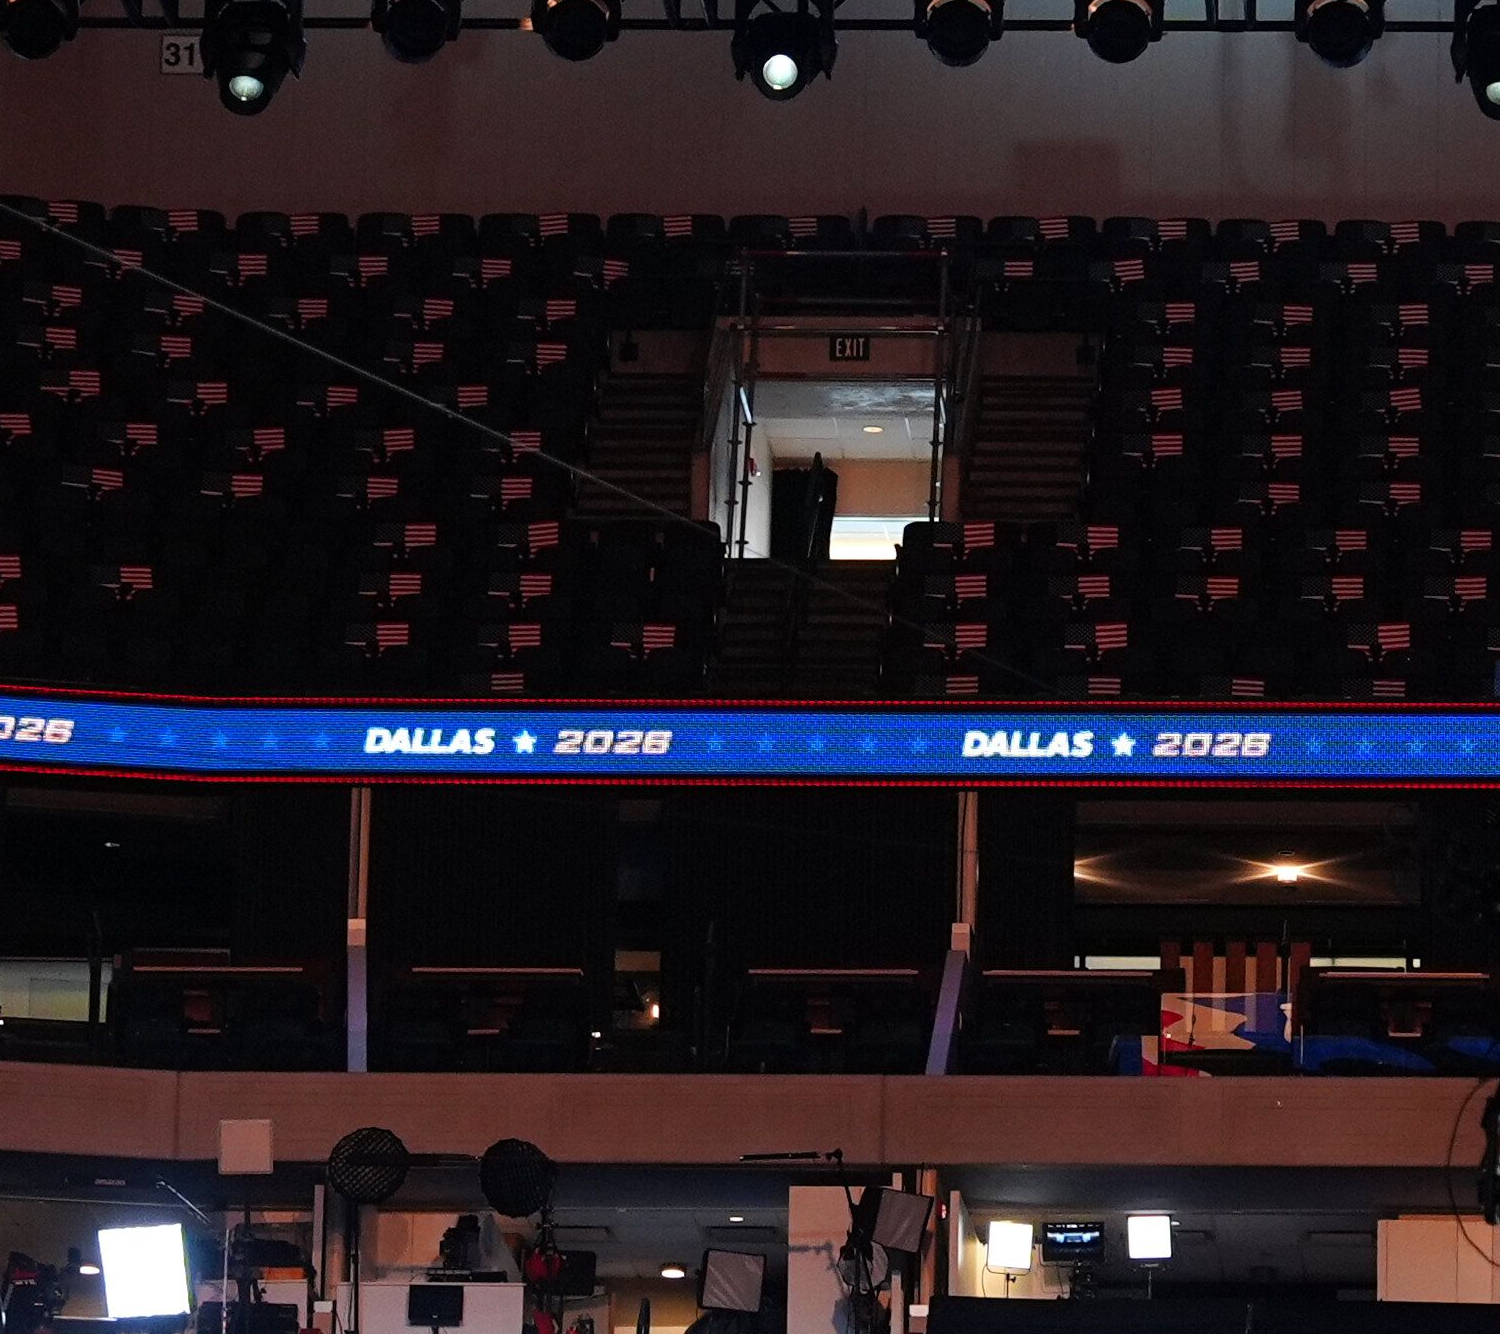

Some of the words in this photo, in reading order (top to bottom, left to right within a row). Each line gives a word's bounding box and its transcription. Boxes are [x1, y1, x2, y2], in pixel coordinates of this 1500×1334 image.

[164, 41, 197, 67] 31
[835, 337, 866, 358] EXIT
[365, 728, 495, 754] DALLAS
[553, 730, 673, 754] 2026
[962, 731, 1093, 757] DALLAS
[1153, 732, 1272, 757] 2026
